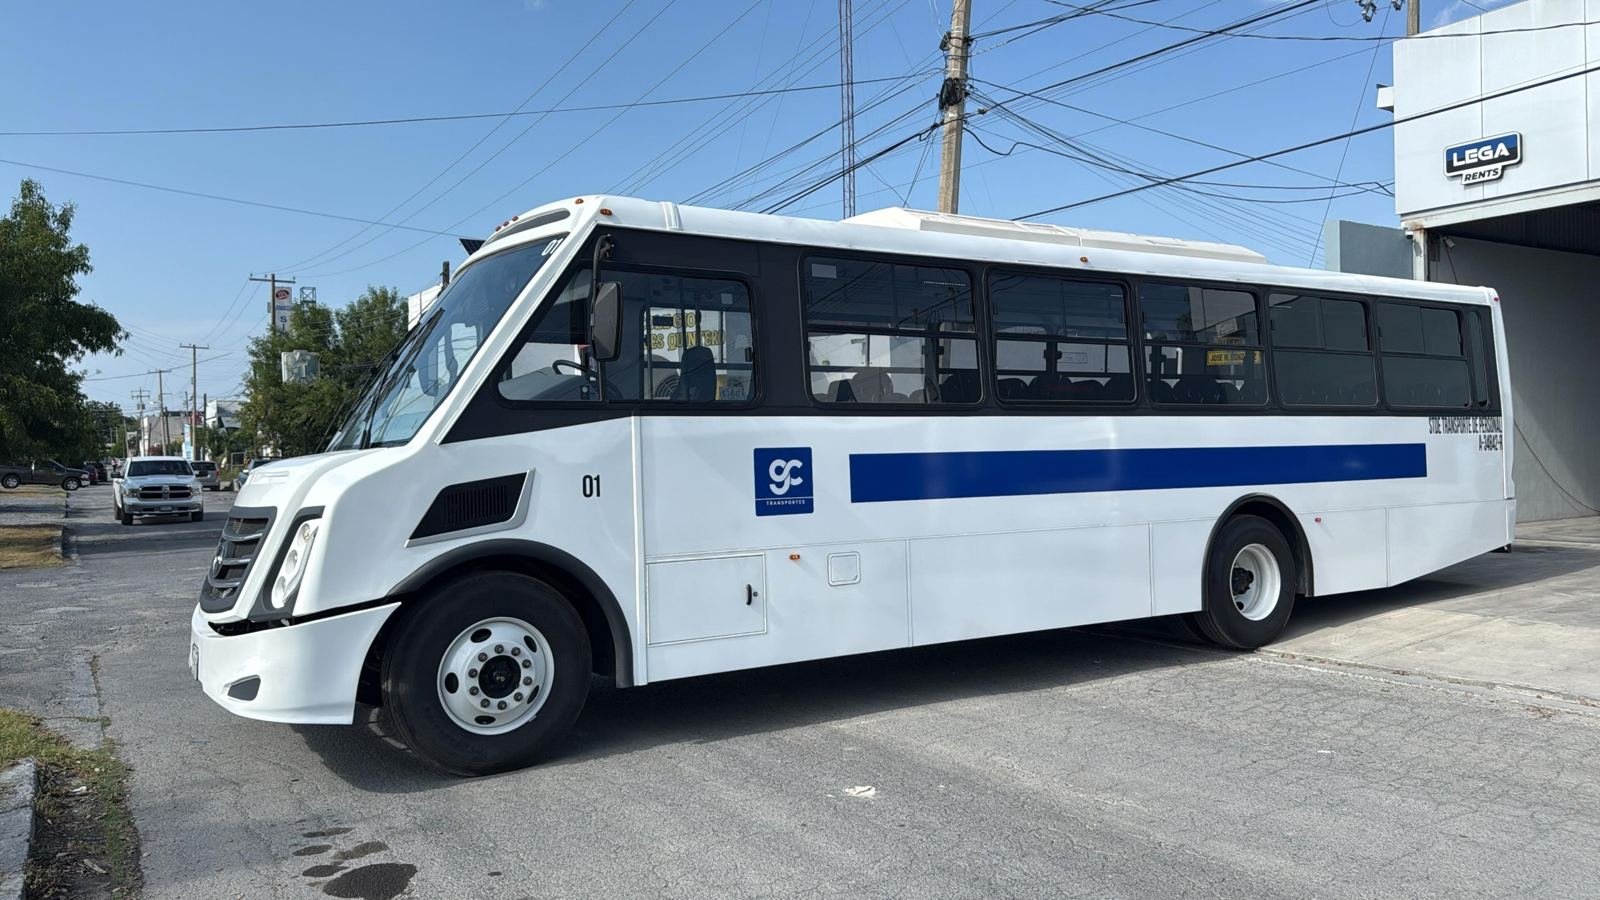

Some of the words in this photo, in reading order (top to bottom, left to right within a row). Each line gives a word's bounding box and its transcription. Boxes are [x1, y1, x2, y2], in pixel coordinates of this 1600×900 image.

[1453, 142, 1510, 167] LEGA
[1464, 168, 1499, 182] RENTS
[541, 238, 564, 256] 01
[1442, 416, 1472, 434] TRANSPORTE
[1472, 416, 1479, 434] DE
[582, 474, 601, 498] 01
